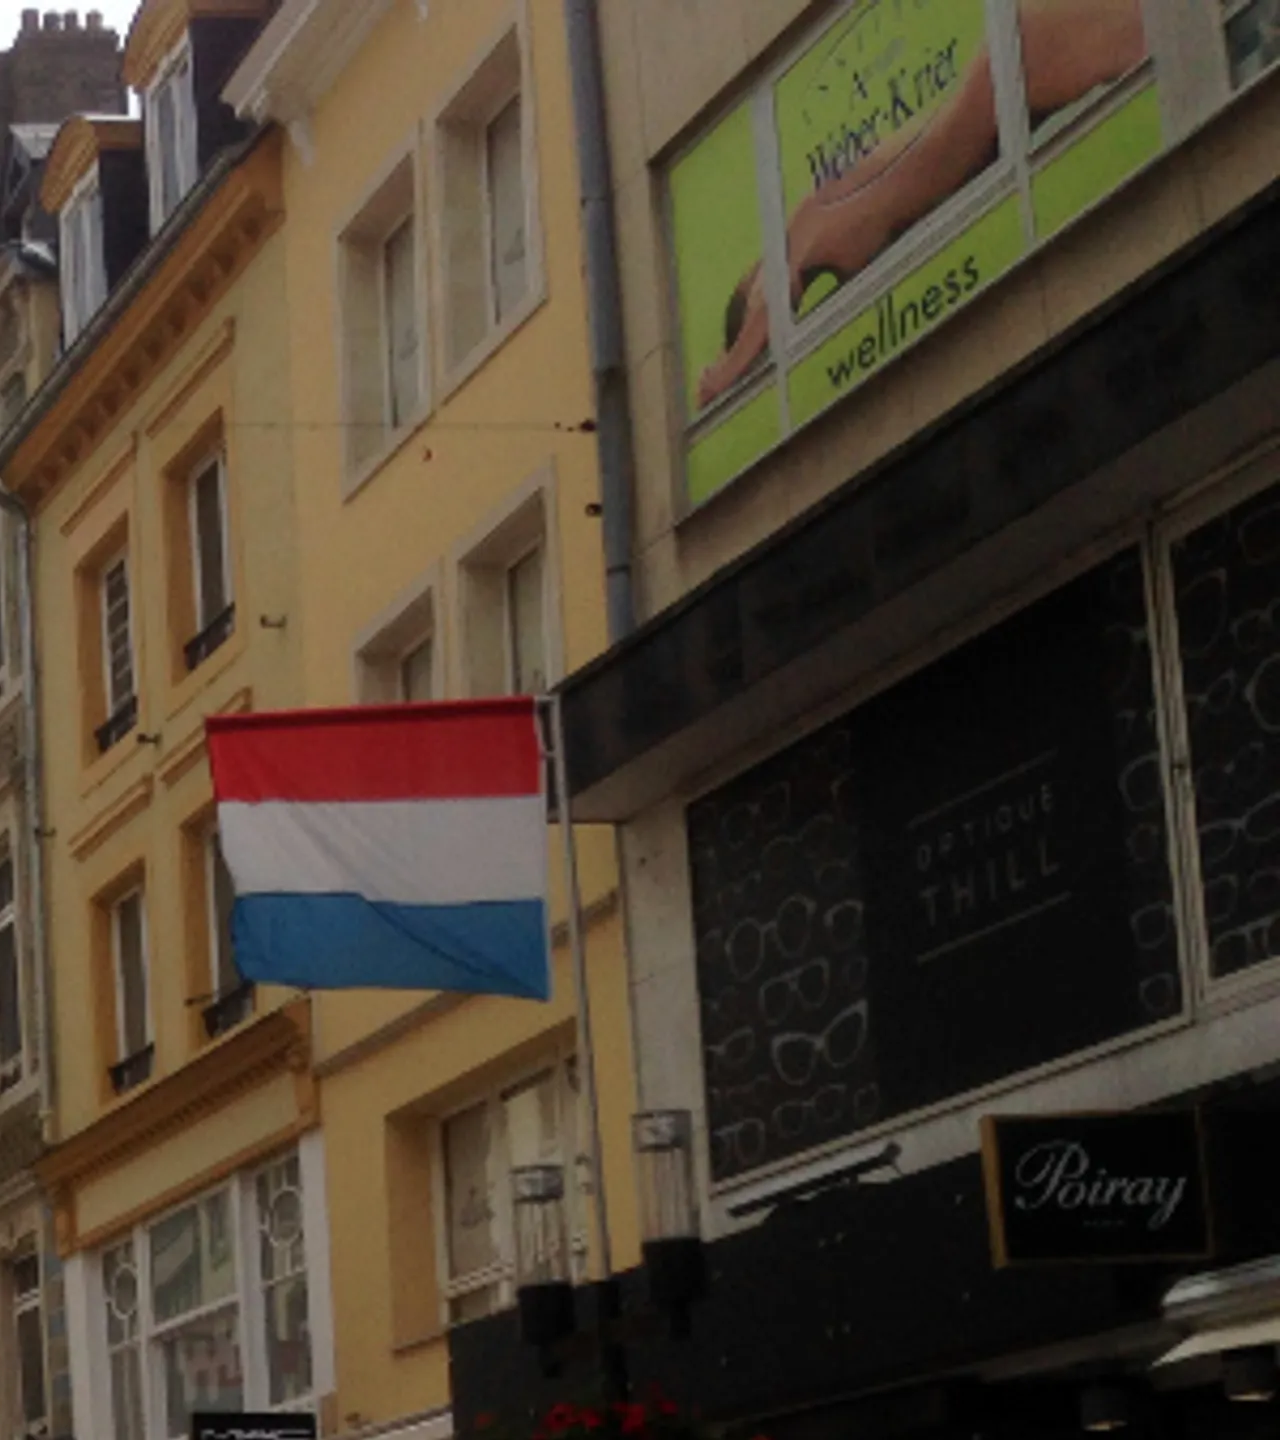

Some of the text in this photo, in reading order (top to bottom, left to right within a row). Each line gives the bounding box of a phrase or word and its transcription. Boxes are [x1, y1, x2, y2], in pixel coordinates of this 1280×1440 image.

[826, 255, 980, 388] wellness
[917, 783, 1053, 872] OPTIQUE
[918, 836, 1060, 927] THILL
[1014, 1138, 1187, 1231] Poiray
